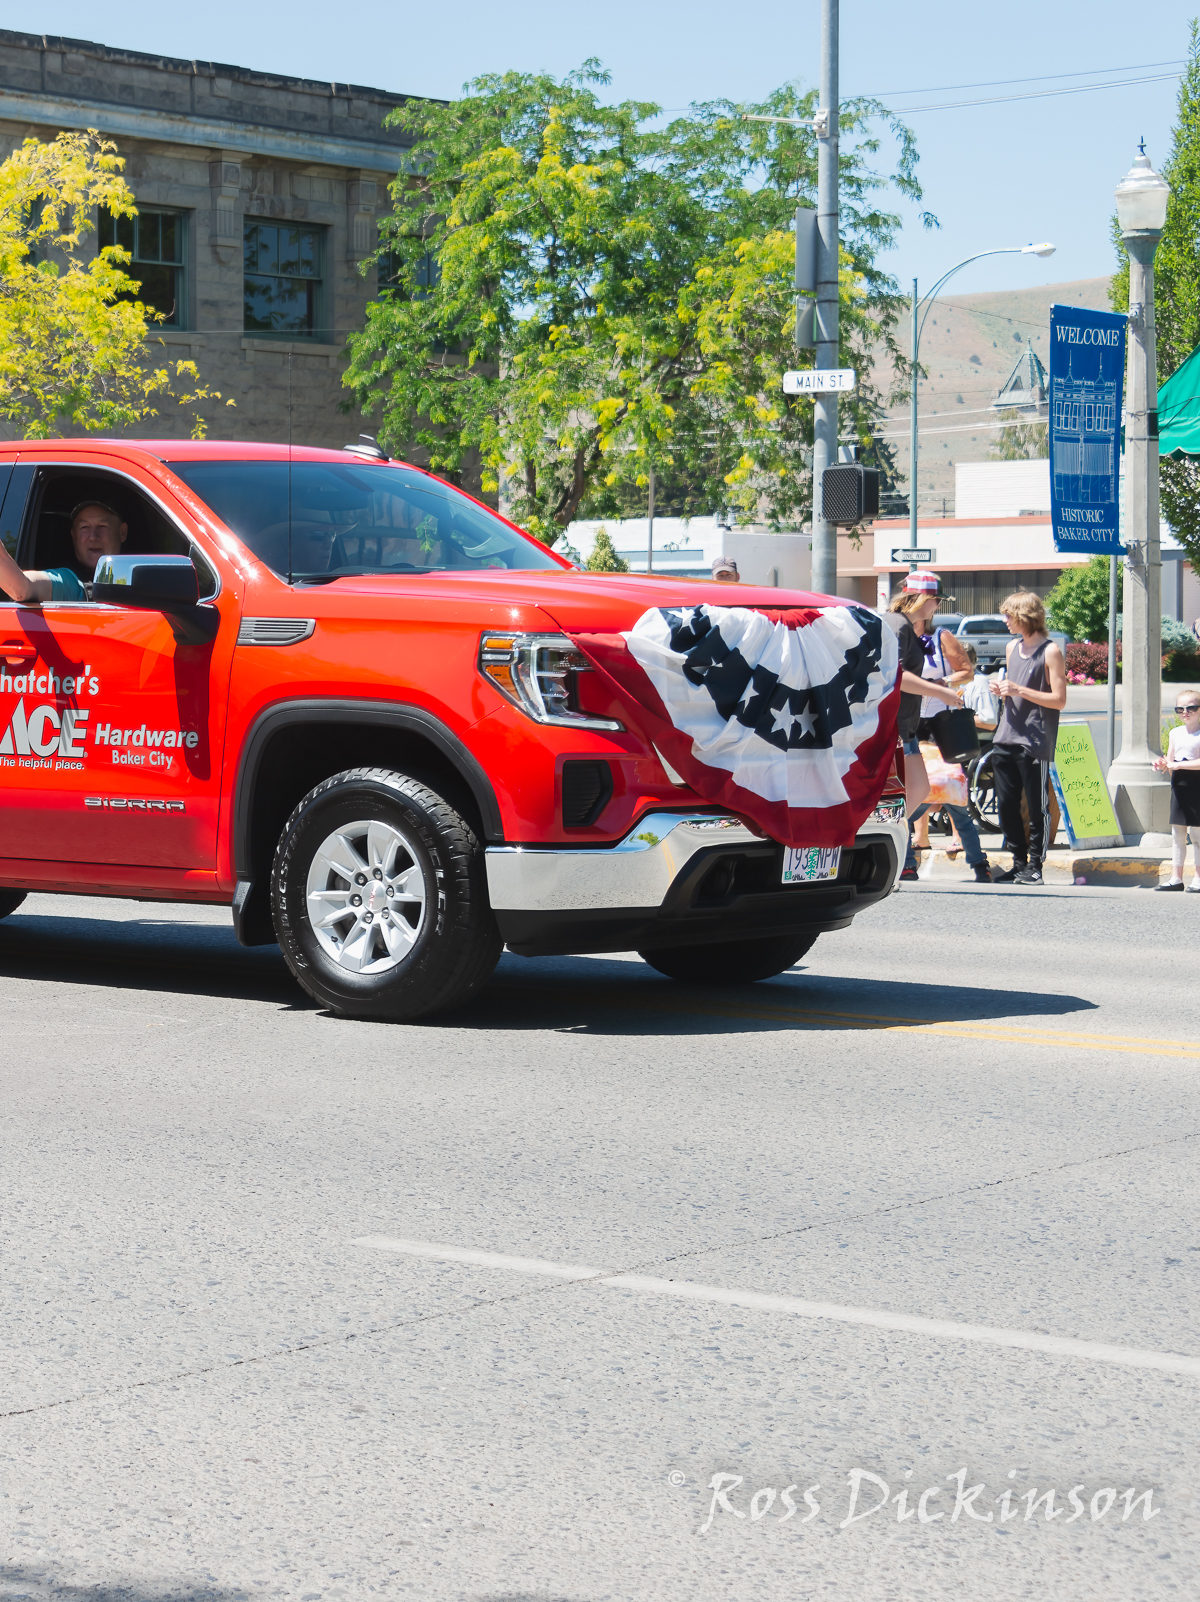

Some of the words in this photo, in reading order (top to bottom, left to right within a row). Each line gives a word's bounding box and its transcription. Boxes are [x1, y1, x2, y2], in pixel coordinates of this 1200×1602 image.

[1056, 325, 1120, 347] WELCOME
[796, 375, 824, 389] MAIN
[1060, 507, 1105, 524] HISTORIC
[1057, 526, 1091, 541] BAKER
[1091, 528, 1115, 542] CITY
[95, 722, 199, 749] Hardware
[18, 757, 52, 770] helpful
[55, 759, 85, 771] place.
[112, 749, 146, 765] Baker
[149, 750, 174, 770] City
[84, 796, 185, 811] SIERRA
